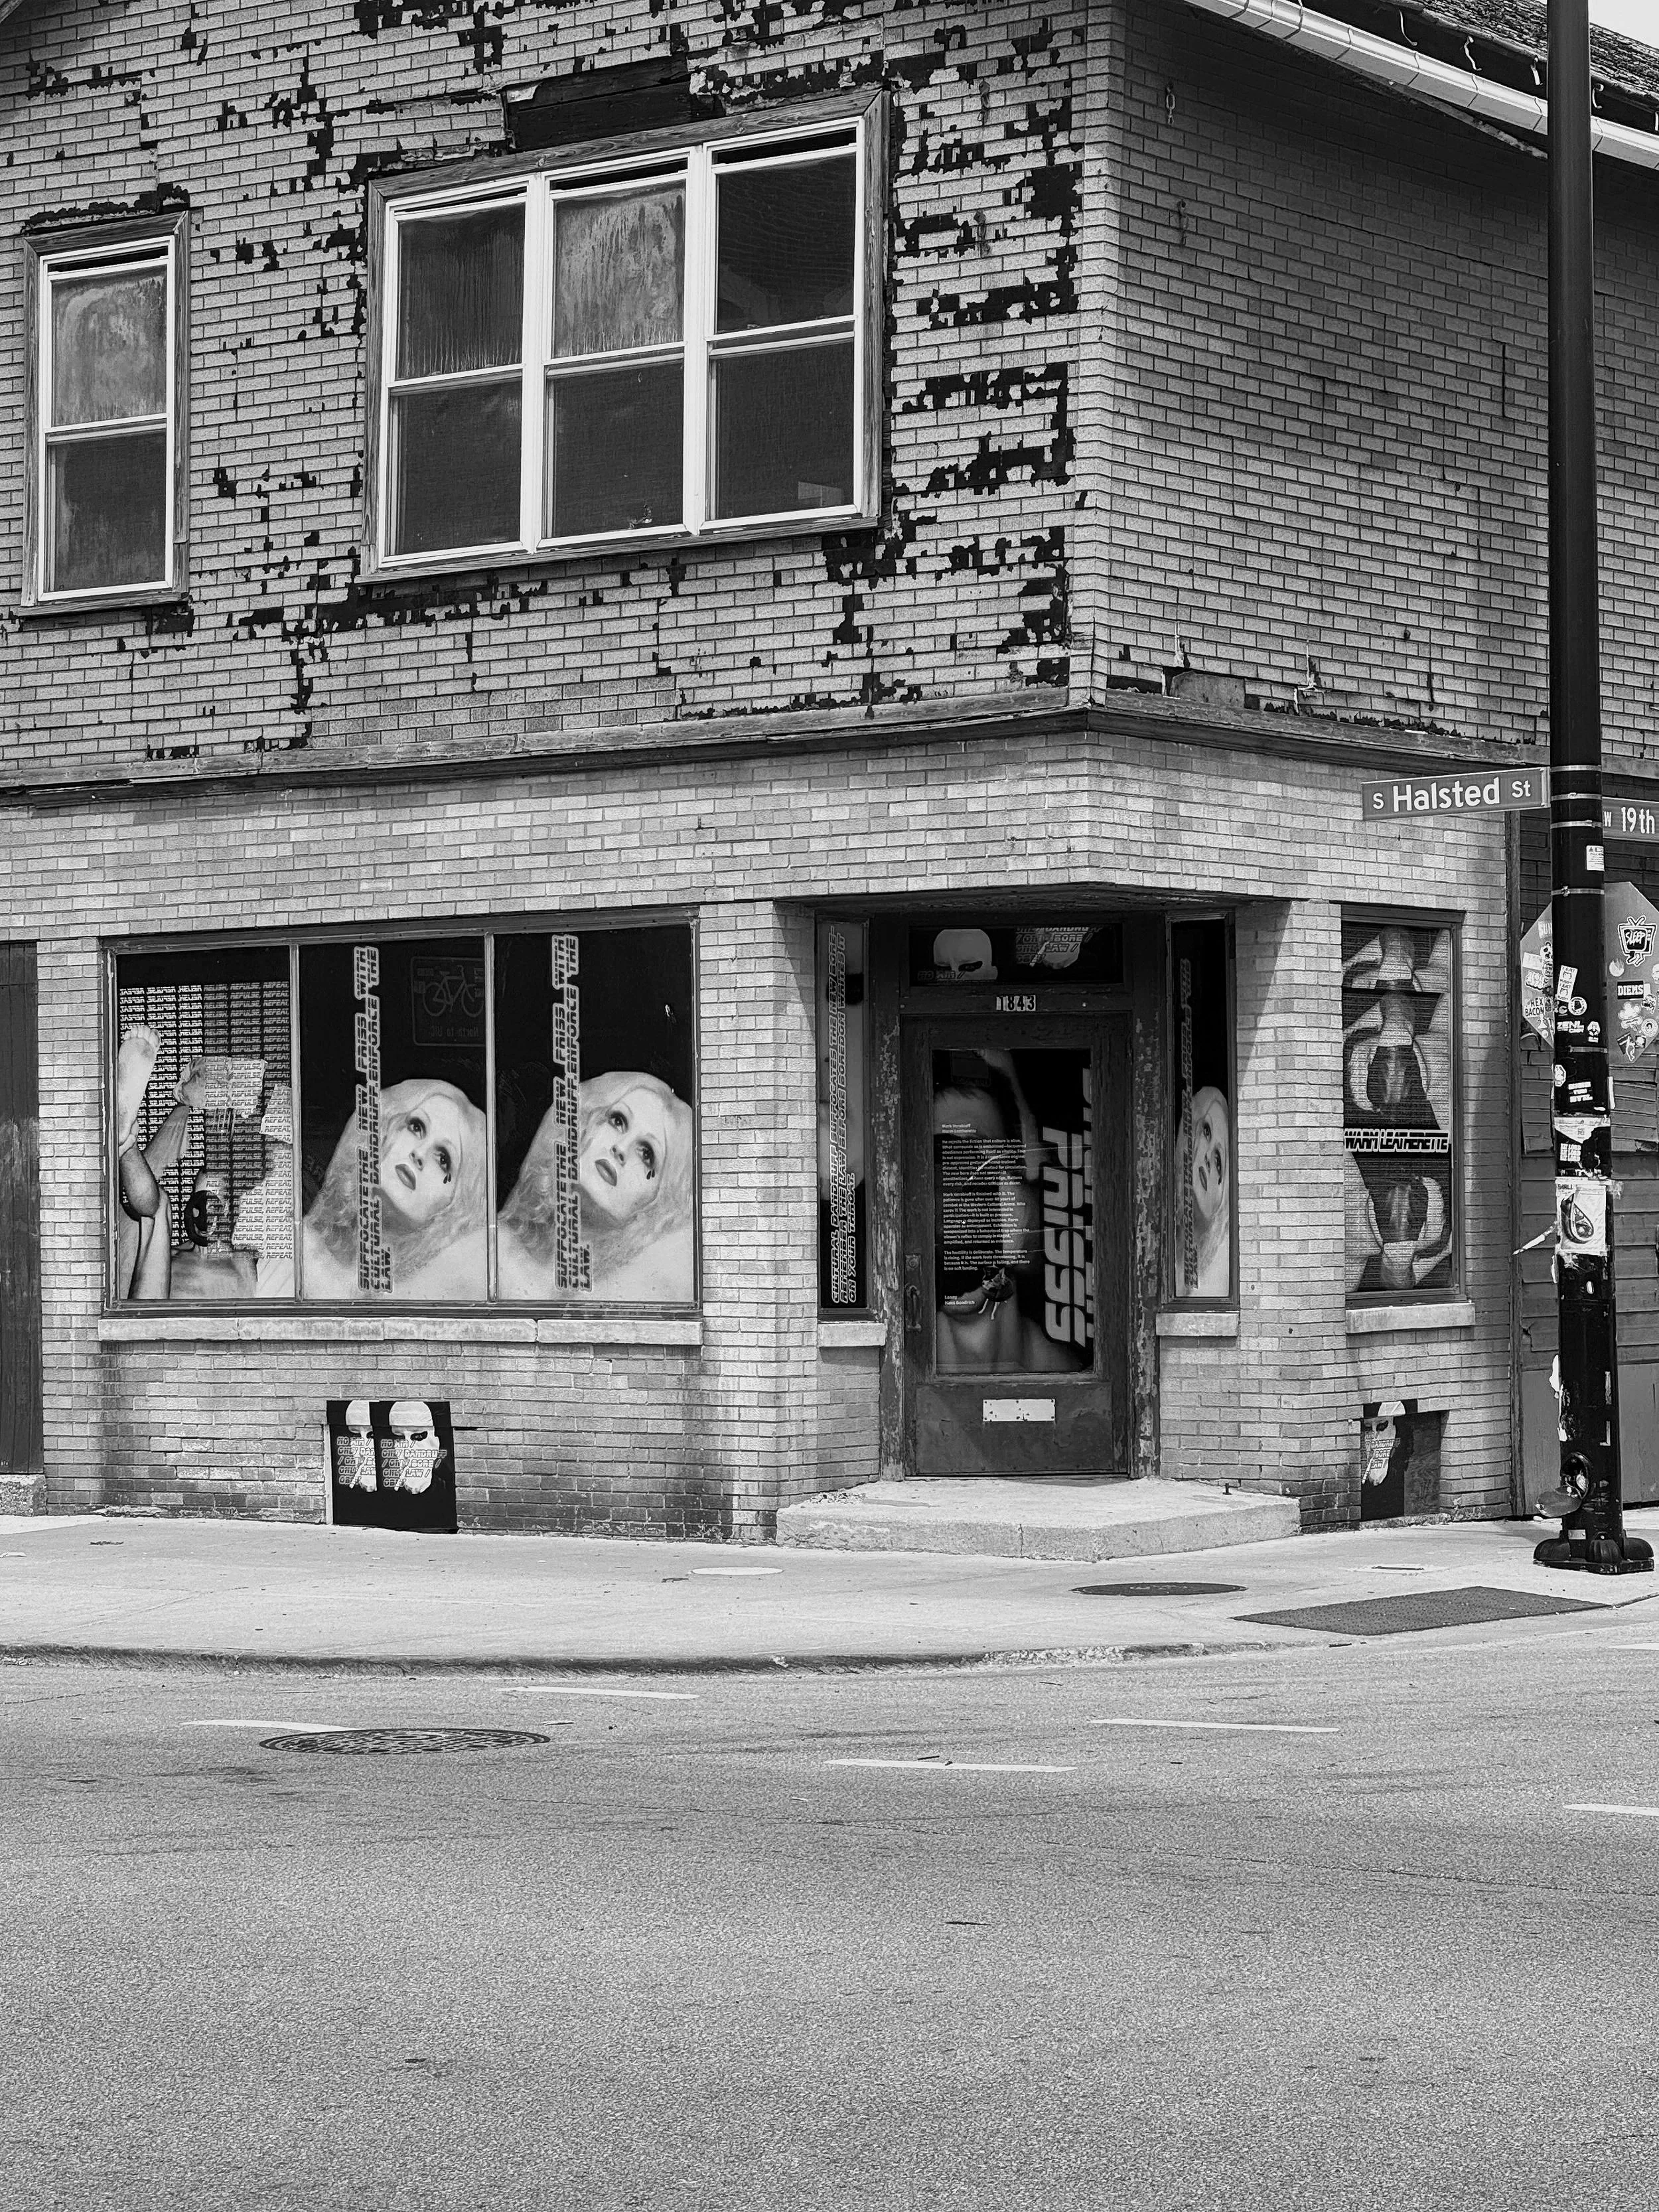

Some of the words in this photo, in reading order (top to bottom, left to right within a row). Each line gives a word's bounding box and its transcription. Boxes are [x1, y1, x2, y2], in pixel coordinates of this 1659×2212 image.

[1373, 792, 1384, 810] S
[1393, 776, 1500, 812] Halsted
[1512, 780, 1531, 798] St
[1604, 811, 1612, 827] W
[1621, 806, 1655, 834] 19th
[1625, 930, 1645, 945] SLEEP
[1045, 943, 1070, 952] LAW
[1617, 985, 1644, 996] DIEMS
[997, 995, 1035, 1011] 1843
[1344, 1130, 1378, 1151] WARM
[403, 1449, 447, 1458] DANDRUFF
[411, 1459, 434, 1467] BORE
[405, 1469, 424, 1478] LAW
